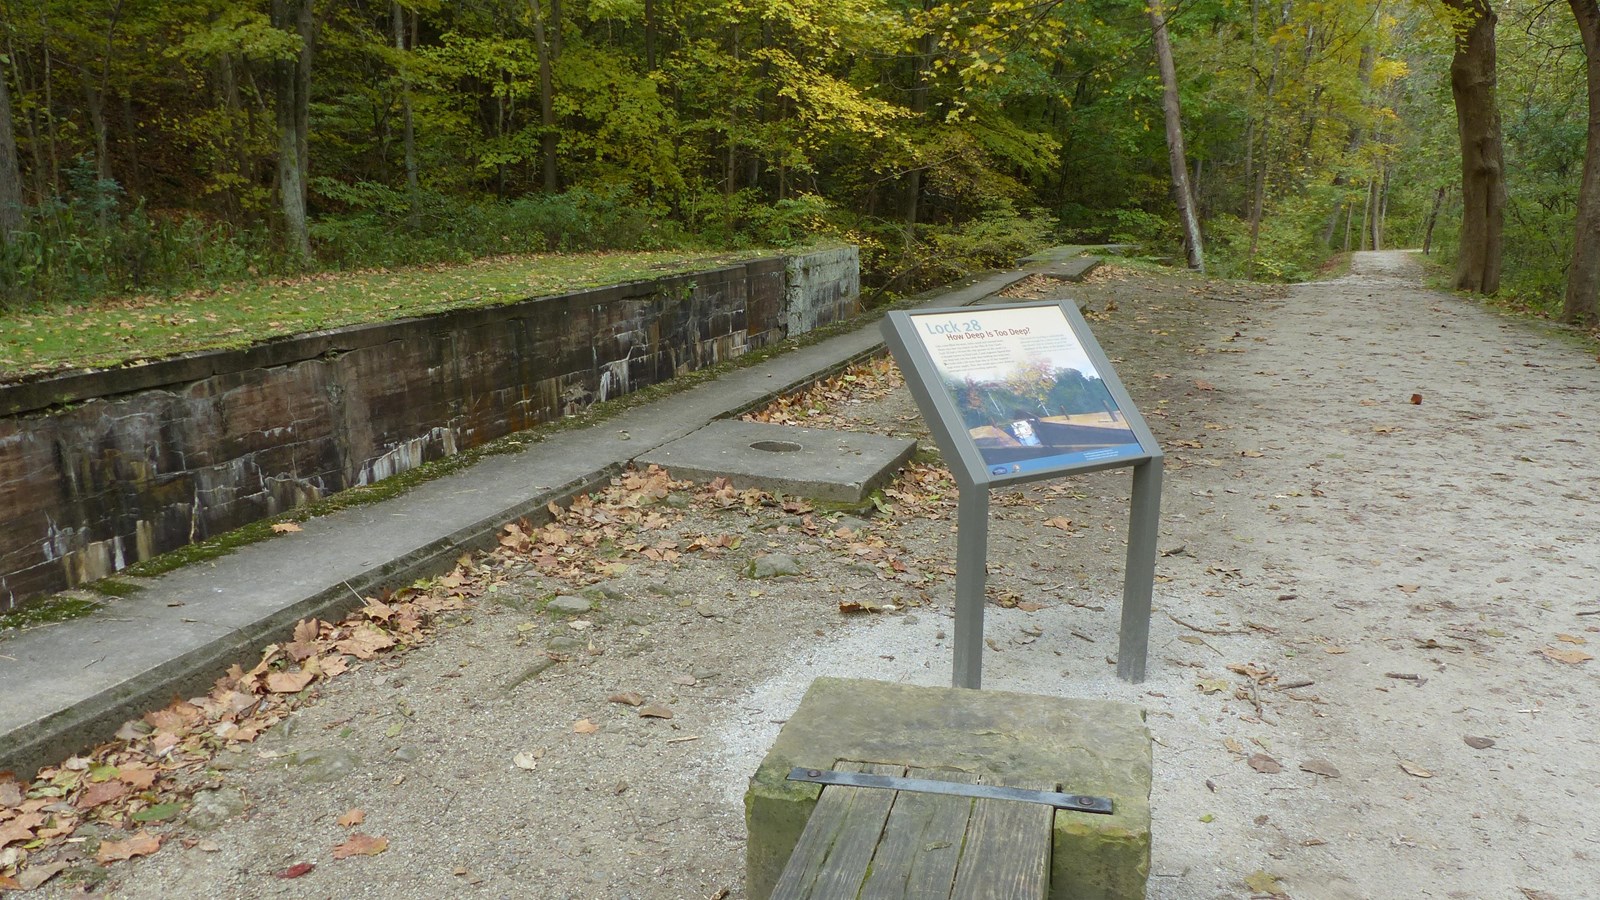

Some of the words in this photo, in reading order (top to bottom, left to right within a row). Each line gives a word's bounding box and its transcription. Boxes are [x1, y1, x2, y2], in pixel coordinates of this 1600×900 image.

[925, 320, 960, 335] Lock
[962, 319, 982, 332] 28
[946, 333, 964, 341] How
[965, 331, 985, 340] Deep
[985, 330, 994, 338] Is
[995, 329, 1008, 337] Too
[1008, 327, 1031, 336] Deep?
